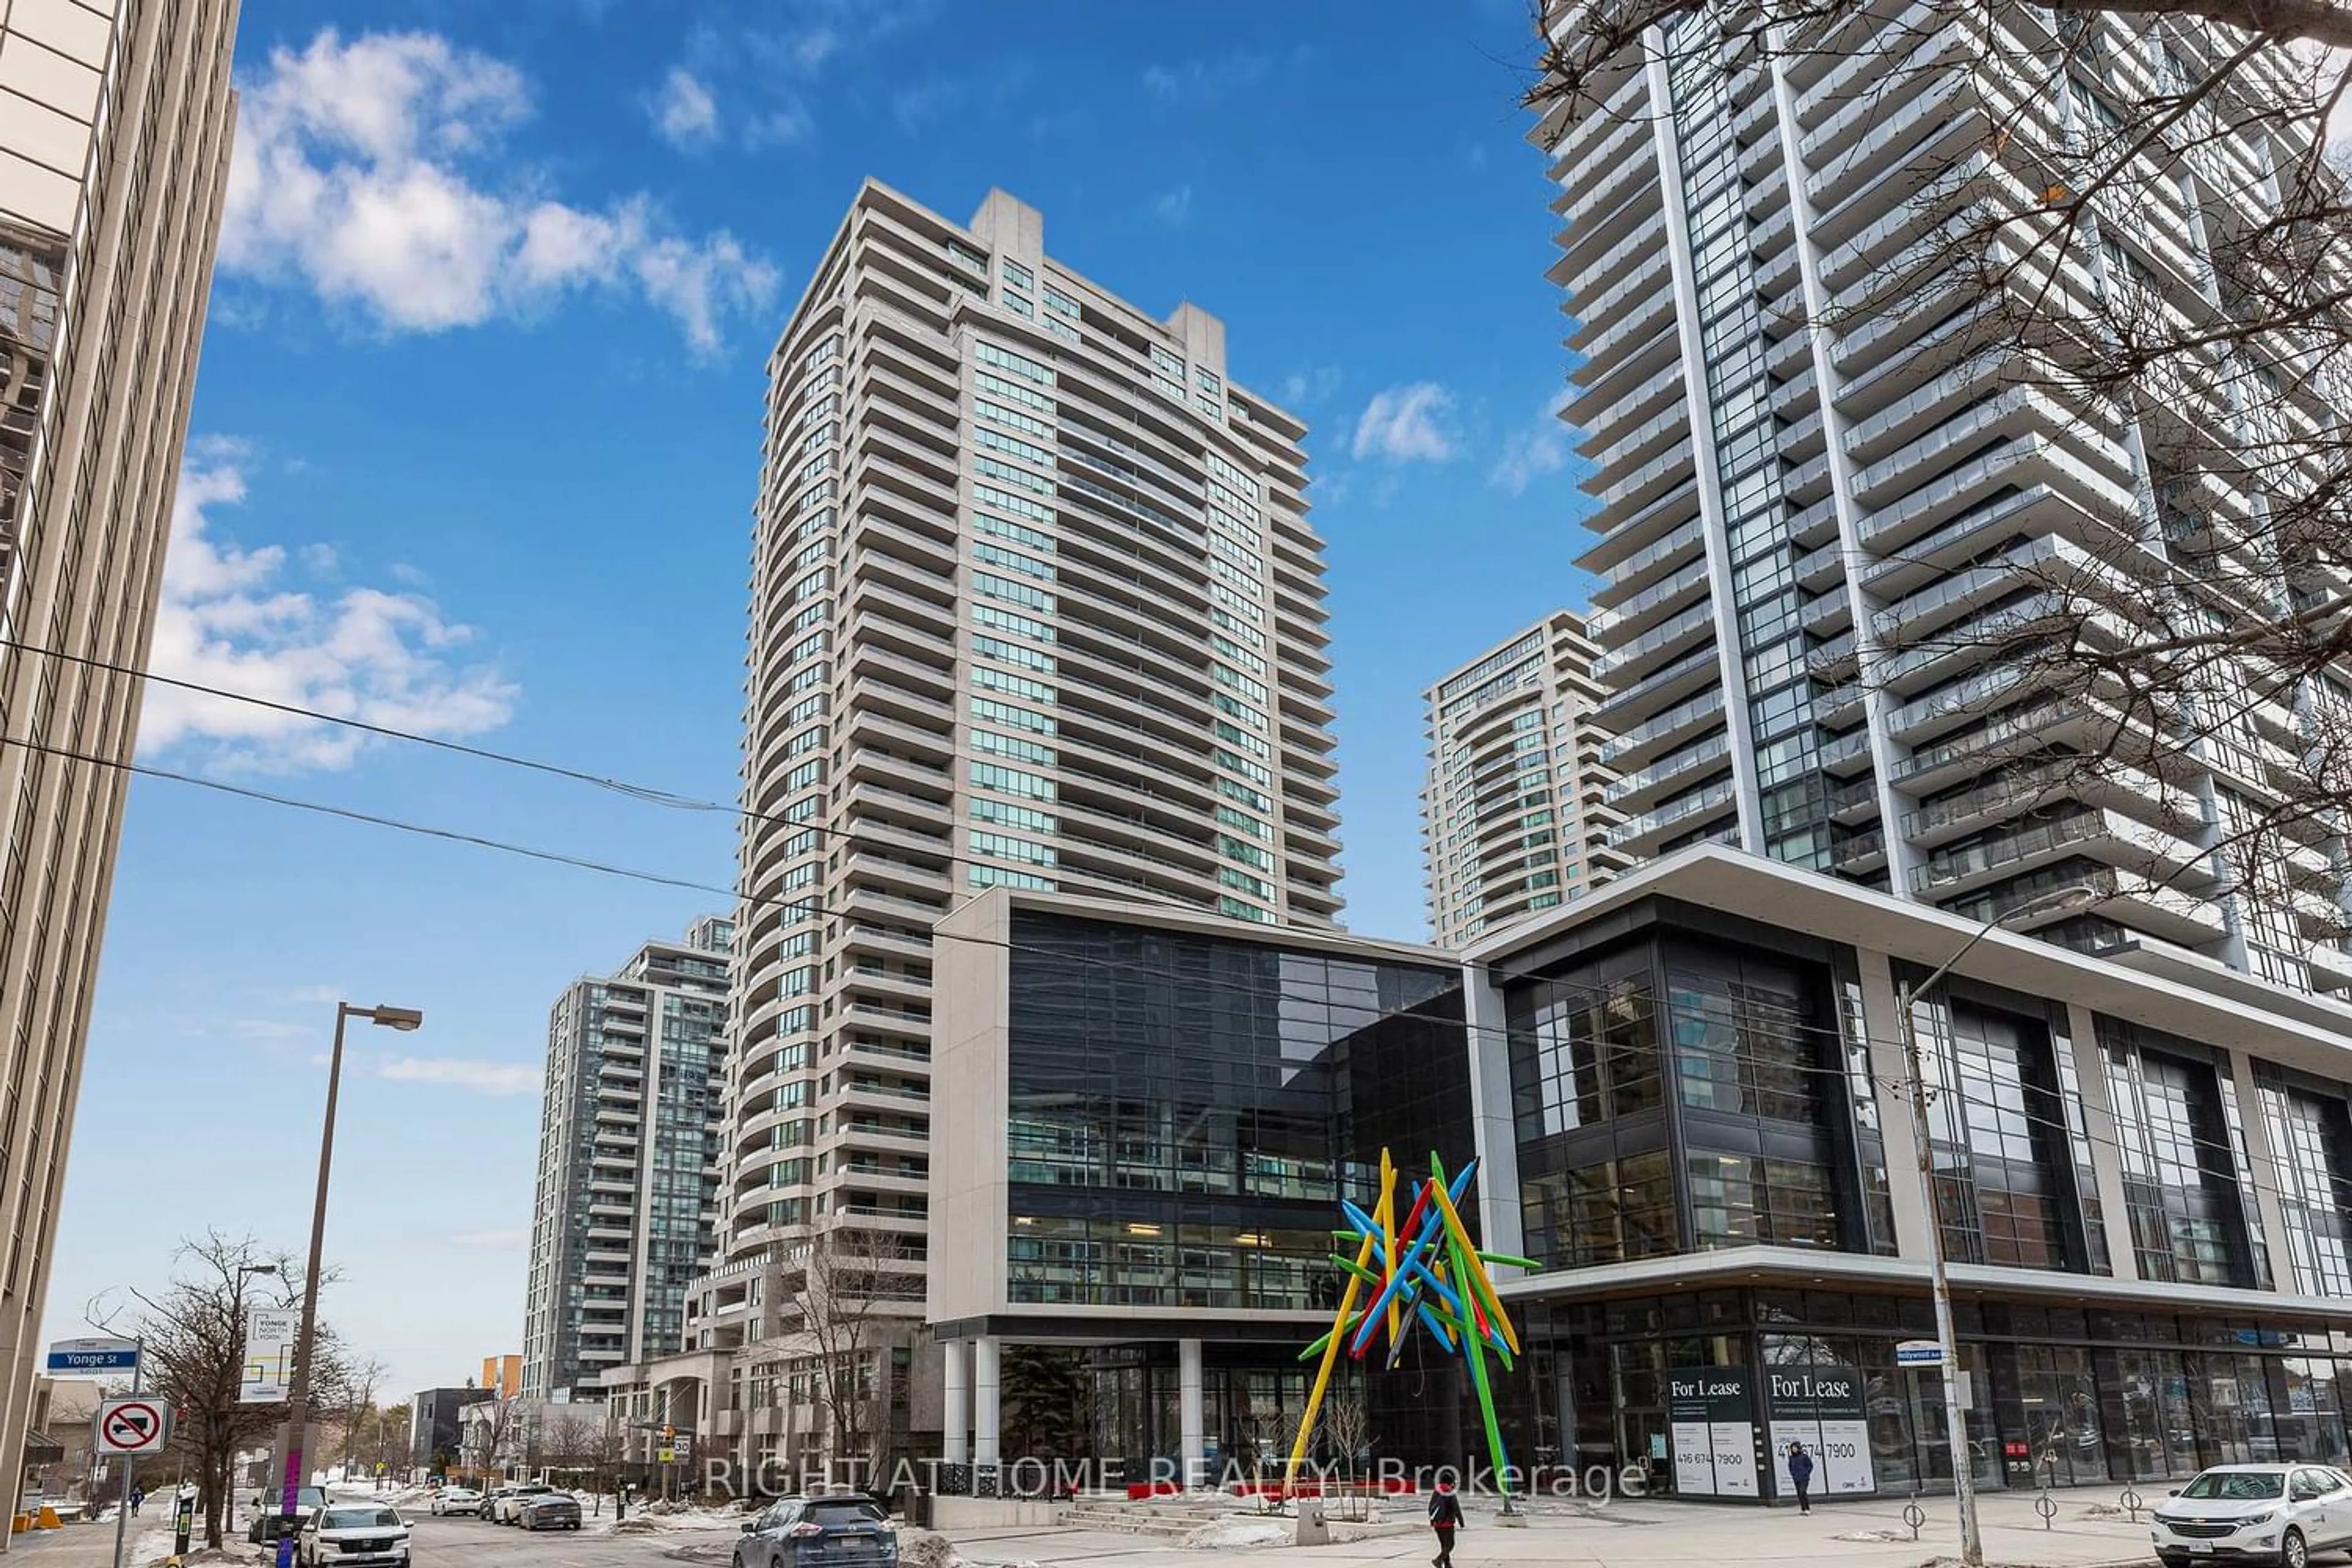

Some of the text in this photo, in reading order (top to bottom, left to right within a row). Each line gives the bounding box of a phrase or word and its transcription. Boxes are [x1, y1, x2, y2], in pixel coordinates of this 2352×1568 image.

[67, 1354, 118, 1366] Yonge St
[1672, 1379, 1741, 1396] For Lease
[1771, 1375, 1850, 1397] For Lease
[1826, 1442, 1855, 1458] 7900
